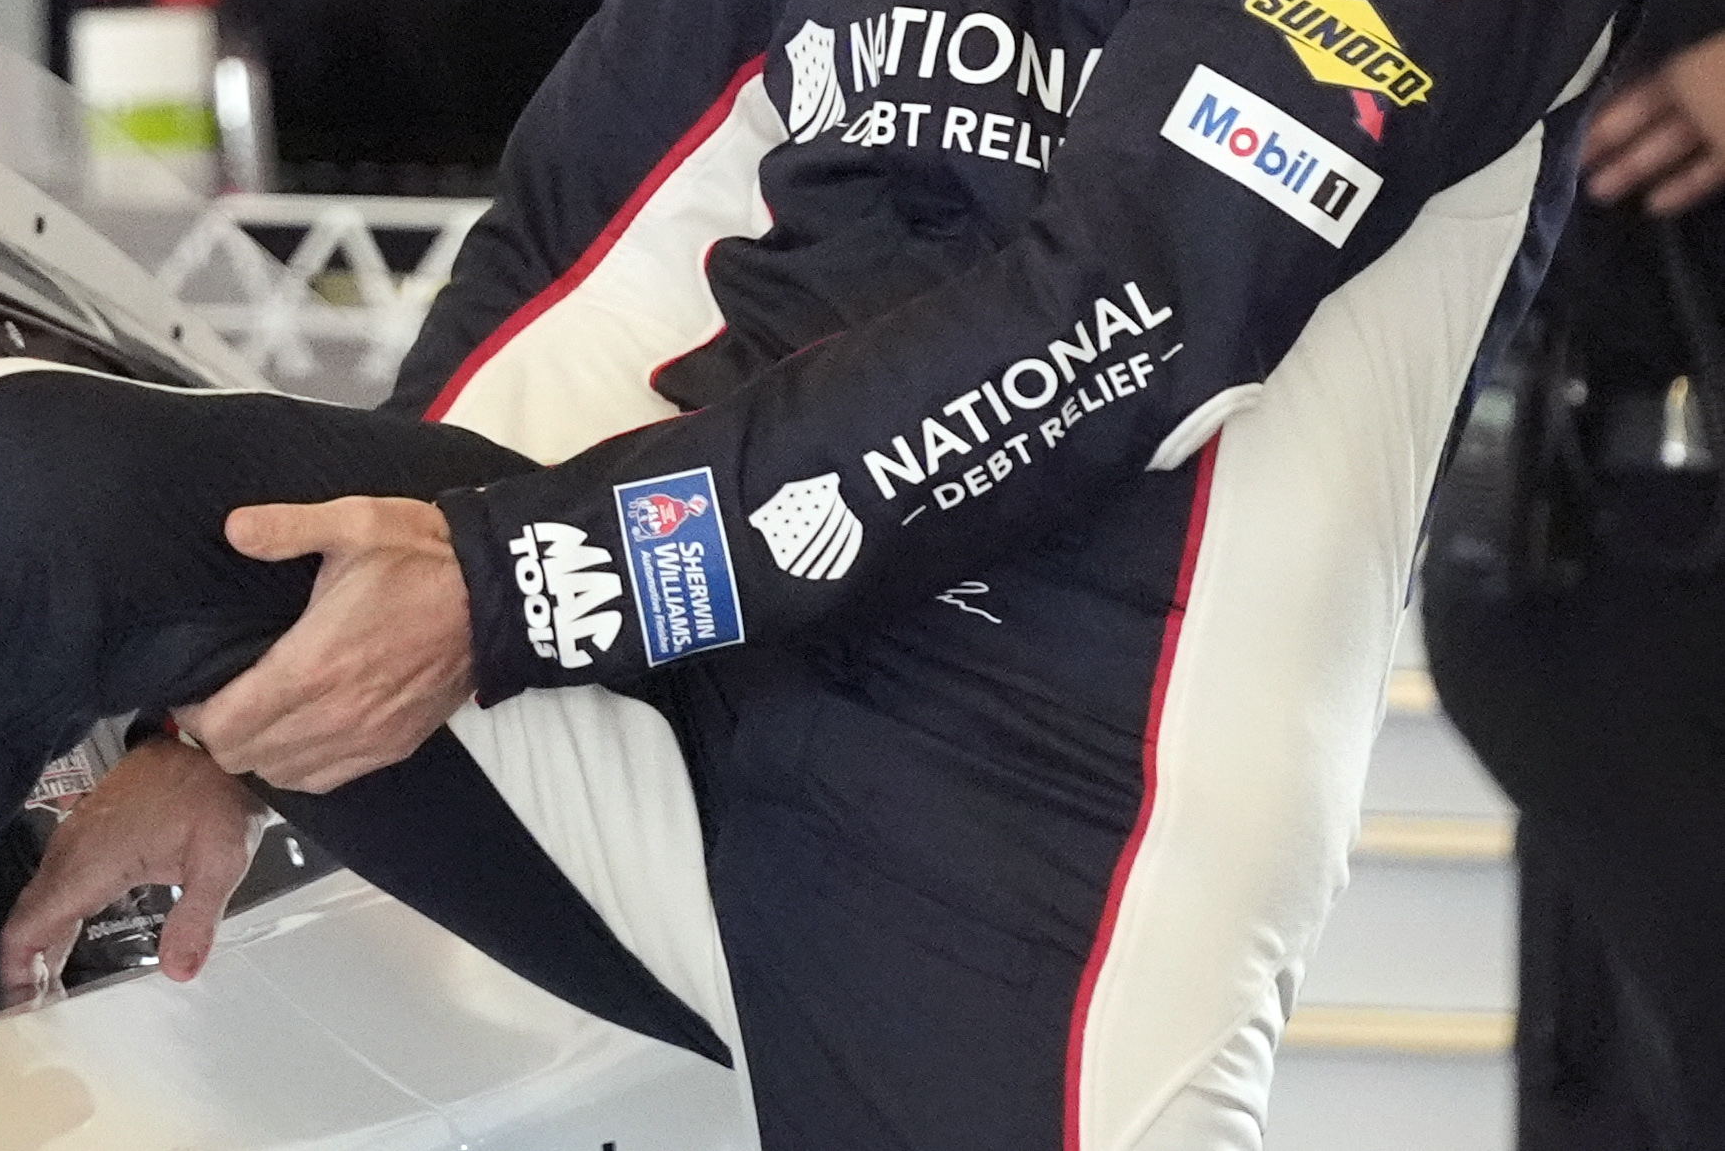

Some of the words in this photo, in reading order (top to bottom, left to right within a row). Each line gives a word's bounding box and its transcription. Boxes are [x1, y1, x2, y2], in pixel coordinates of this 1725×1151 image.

[1188, 93, 1320, 194] Mobil
[1323, 178, 1349, 214] 1
[863, 281, 1173, 500] NATIONAL
[932, 433, 1032, 510] DEBT
[1038, 353, 1154, 449] RELIEF
[532, 522, 623, 669] MAC
[653, 542, 692, 646] WILLIAMS
[679, 541, 717, 640] SHERWIN
